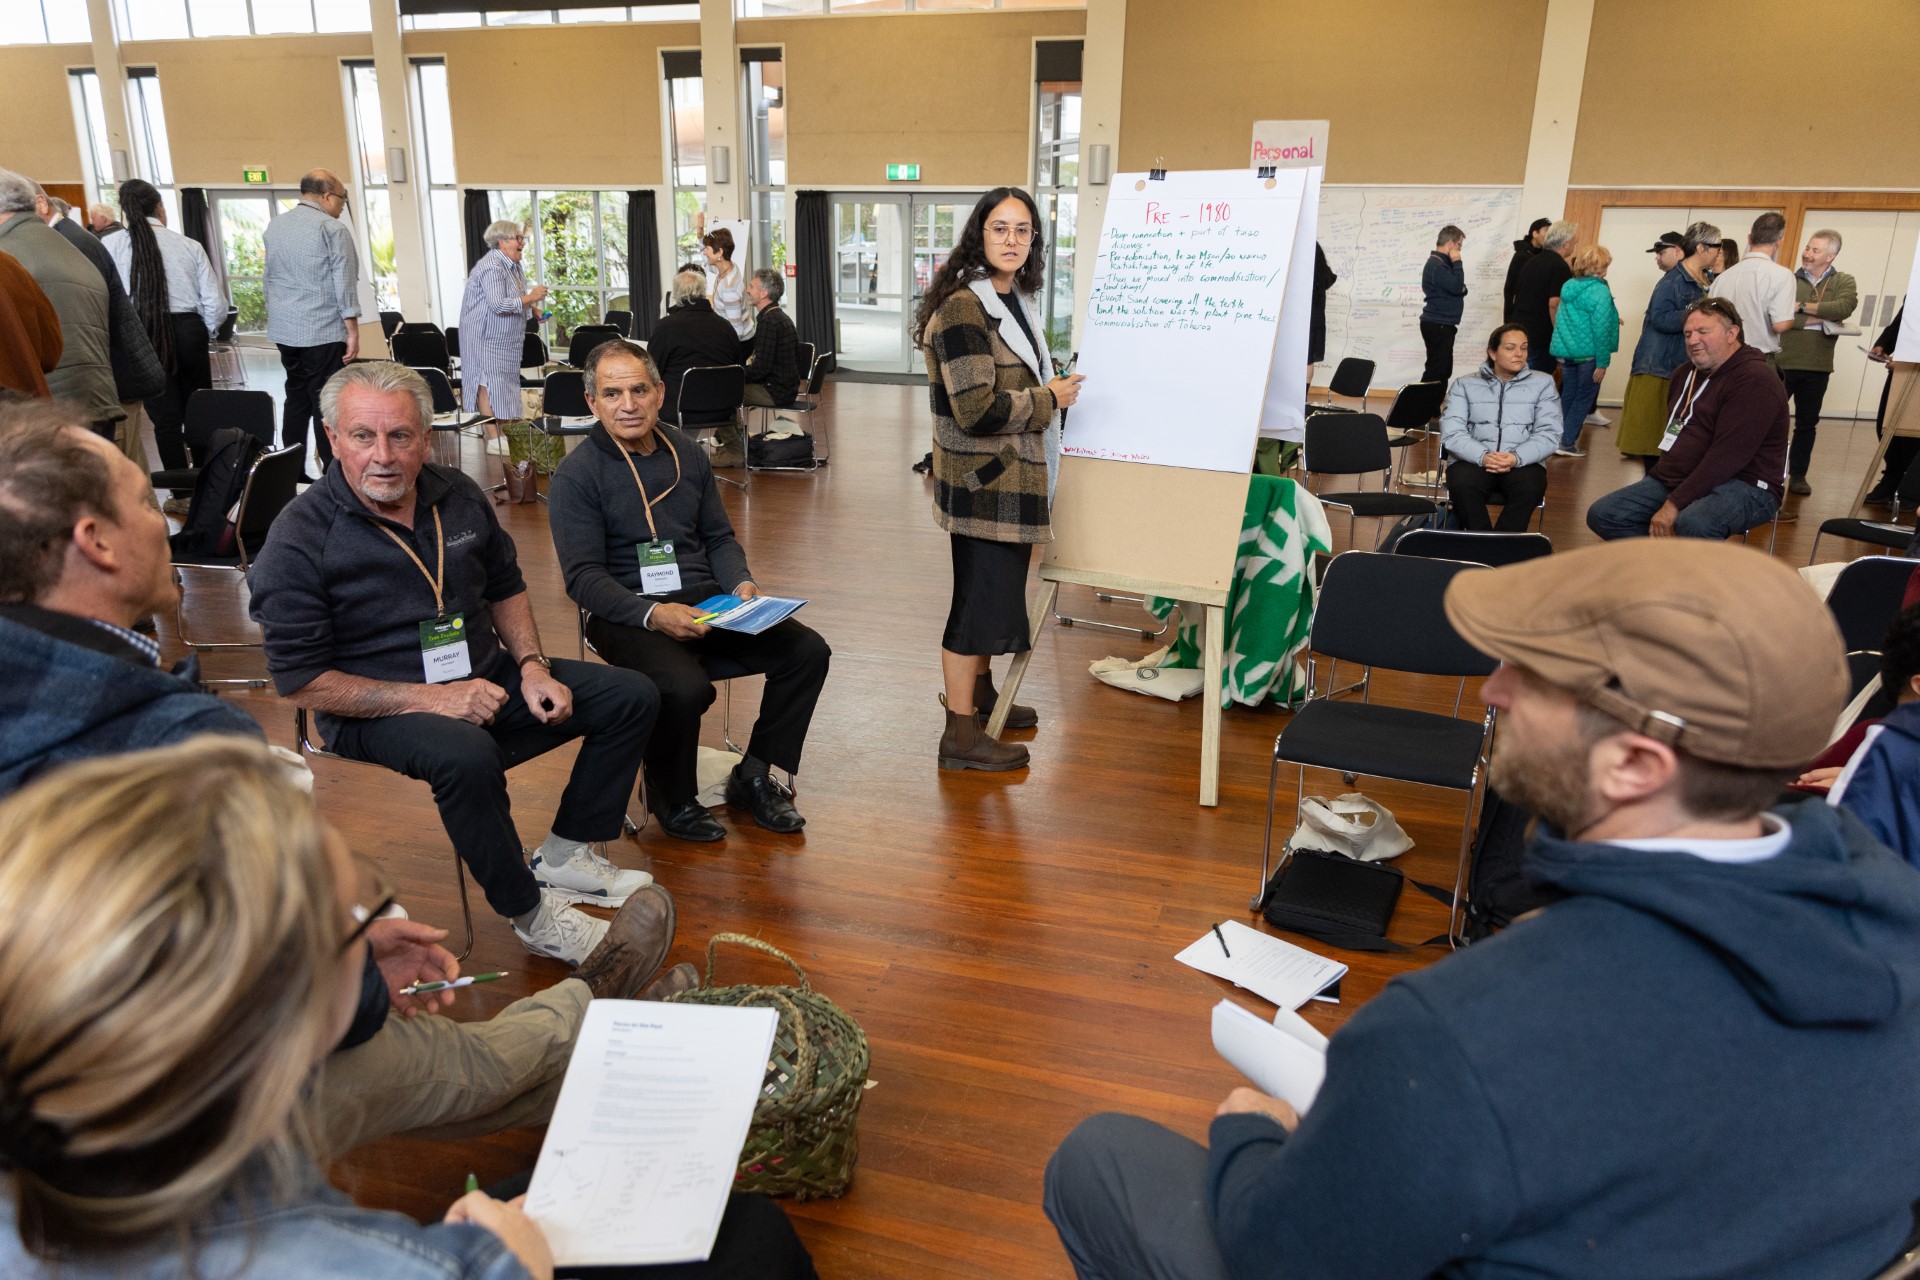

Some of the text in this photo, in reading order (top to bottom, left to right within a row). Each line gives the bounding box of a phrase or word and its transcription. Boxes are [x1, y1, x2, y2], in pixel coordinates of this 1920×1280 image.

[1253, 137, 1315, 161] Personal
[248, 171, 263, 182] EXIT
[1145, 201, 1171, 225] PRE
[1199, 201, 1231, 224] 1980
[1132, 228, 1173, 239] connection
[1217, 225, 1229, 236] of
[1162, 264, 1180, 275] way
[1184, 260, 1195, 270] of
[1106, 273, 1127, 283] Then
[1146, 273, 1171, 282] moved
[1177, 272, 1195, 283] into
[1127, 293, 1149, 305] Sand
[1152, 296, 1184, 309] covering
[1187, 293, 1200, 306] all
[1204, 296, 1217, 308] the
[1116, 304, 1129, 315] the
[1132, 305, 1165, 316] solution
[1169, 308, 1187, 316] was
[1189, 306, 1199, 316] to
[1203, 308, 1229, 320] plant
[1234, 312, 1253, 325] pine
[1257, 308, 1277, 322] trees
[1163, 318, 1175, 329] of
[433, 652, 460, 664] MURRAY
